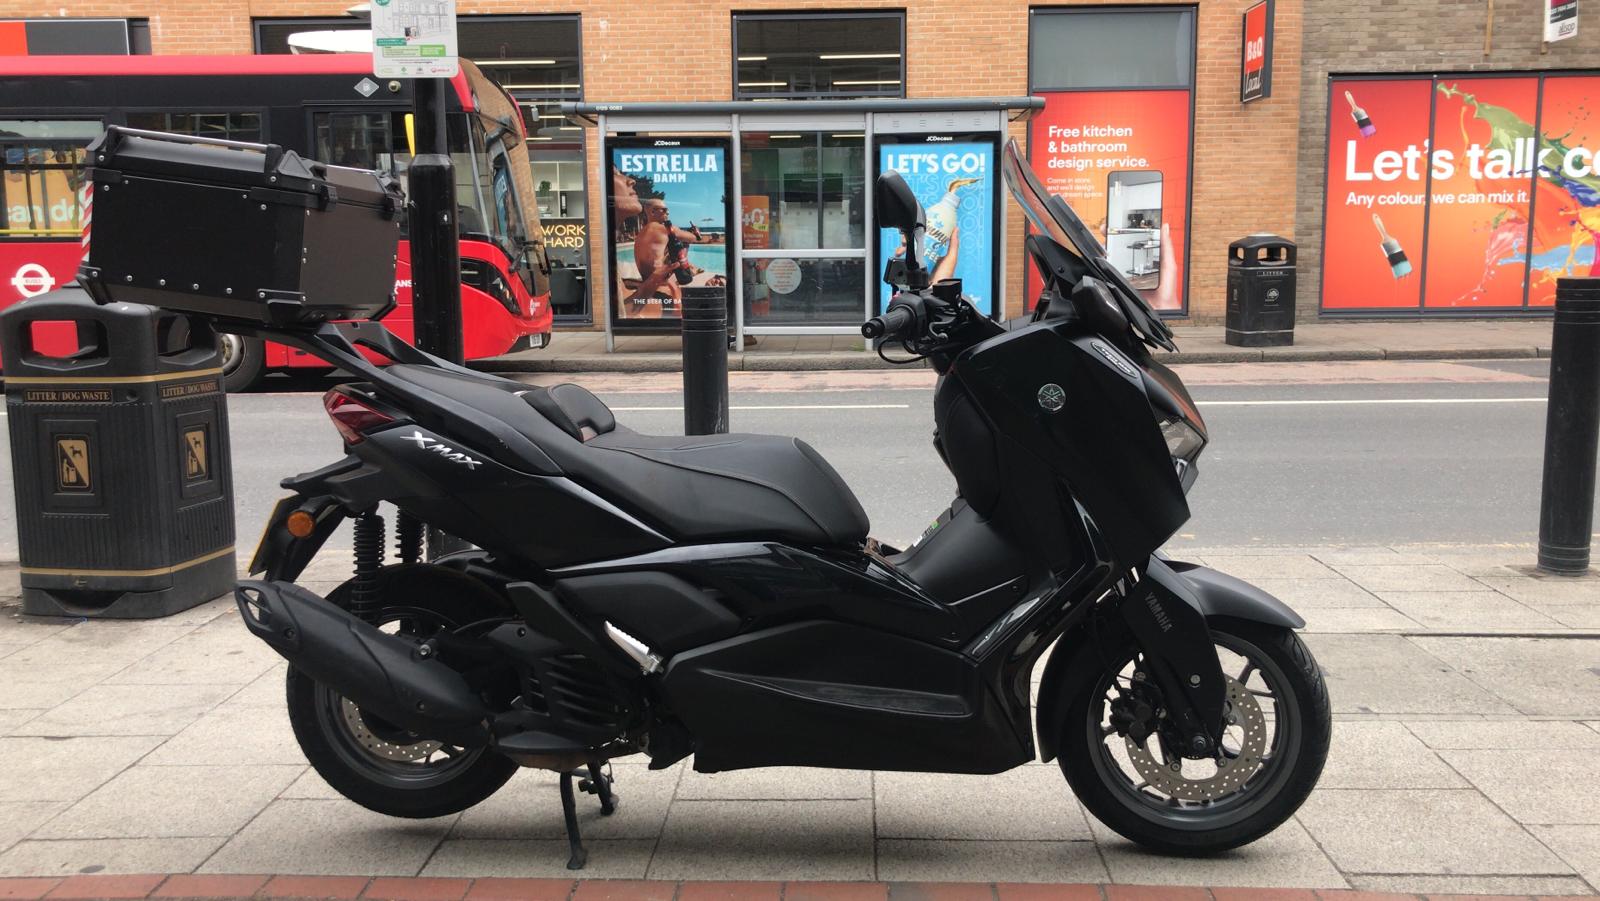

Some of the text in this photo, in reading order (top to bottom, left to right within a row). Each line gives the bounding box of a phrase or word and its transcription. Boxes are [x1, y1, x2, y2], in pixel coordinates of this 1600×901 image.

[1247, 36, 1263, 62] B&Q
[1048, 125, 1132, 138] Free kitchen
[1048, 141, 1127, 153] & bathroom
[621, 154, 718, 172] ESTRELLA
[887, 152, 986, 174] LET'S GO!
[1048, 156, 1149, 171] design service.
[1345, 139, 1454, 181] Let's
[1466, 137, 1553, 179] talk
[653, 173, 687, 183] DAMM
[1074, 184, 1094, 192] design
[1345, 191, 1530, 209] Any colour, we can mix it.
[540, 224, 586, 236] WORK
[544, 237, 584, 248] HARD
[27, 391, 57, 401] LITTER
[62, 391, 81, 401] DOG
[81, 391, 110, 401] WASTE
[162, 387, 184, 397] LITTER
[187, 385, 200, 393] DOG
[200, 382, 216, 392] WASTE
[1145, 591, 1172, 633] YAMAHA
